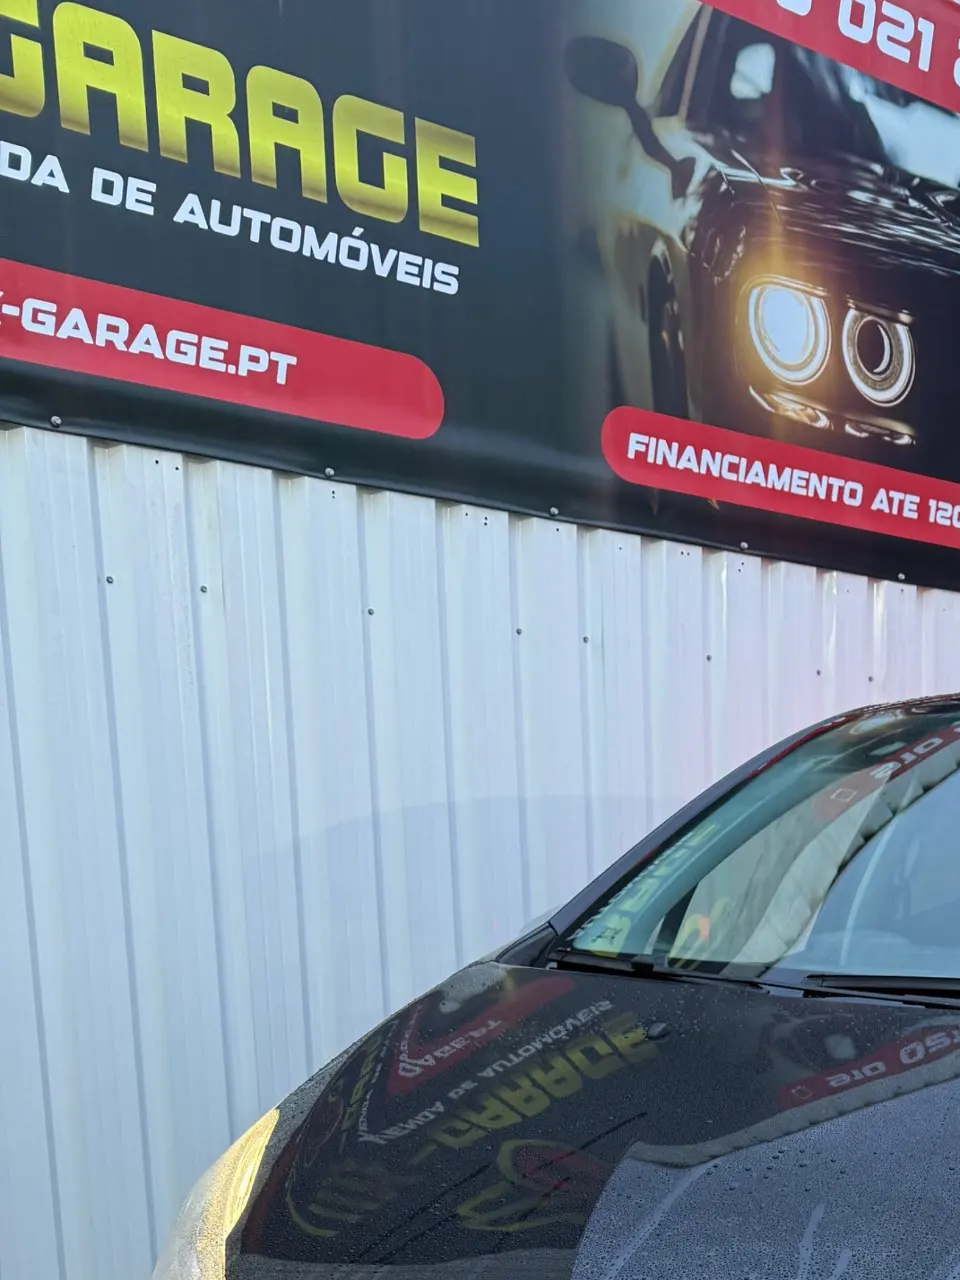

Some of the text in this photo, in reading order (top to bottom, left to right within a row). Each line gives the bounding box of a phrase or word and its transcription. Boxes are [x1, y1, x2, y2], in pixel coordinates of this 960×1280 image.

[838, 0, 935, 72] 021
[0, 140, 459, 296] DA DE AUTOMÓVEIS
[0, 290, 298, 386] -GARAGE.PT
[626, 432, 863, 507] FINANCIAMENTO
[870, 487, 920, 520] ATE
